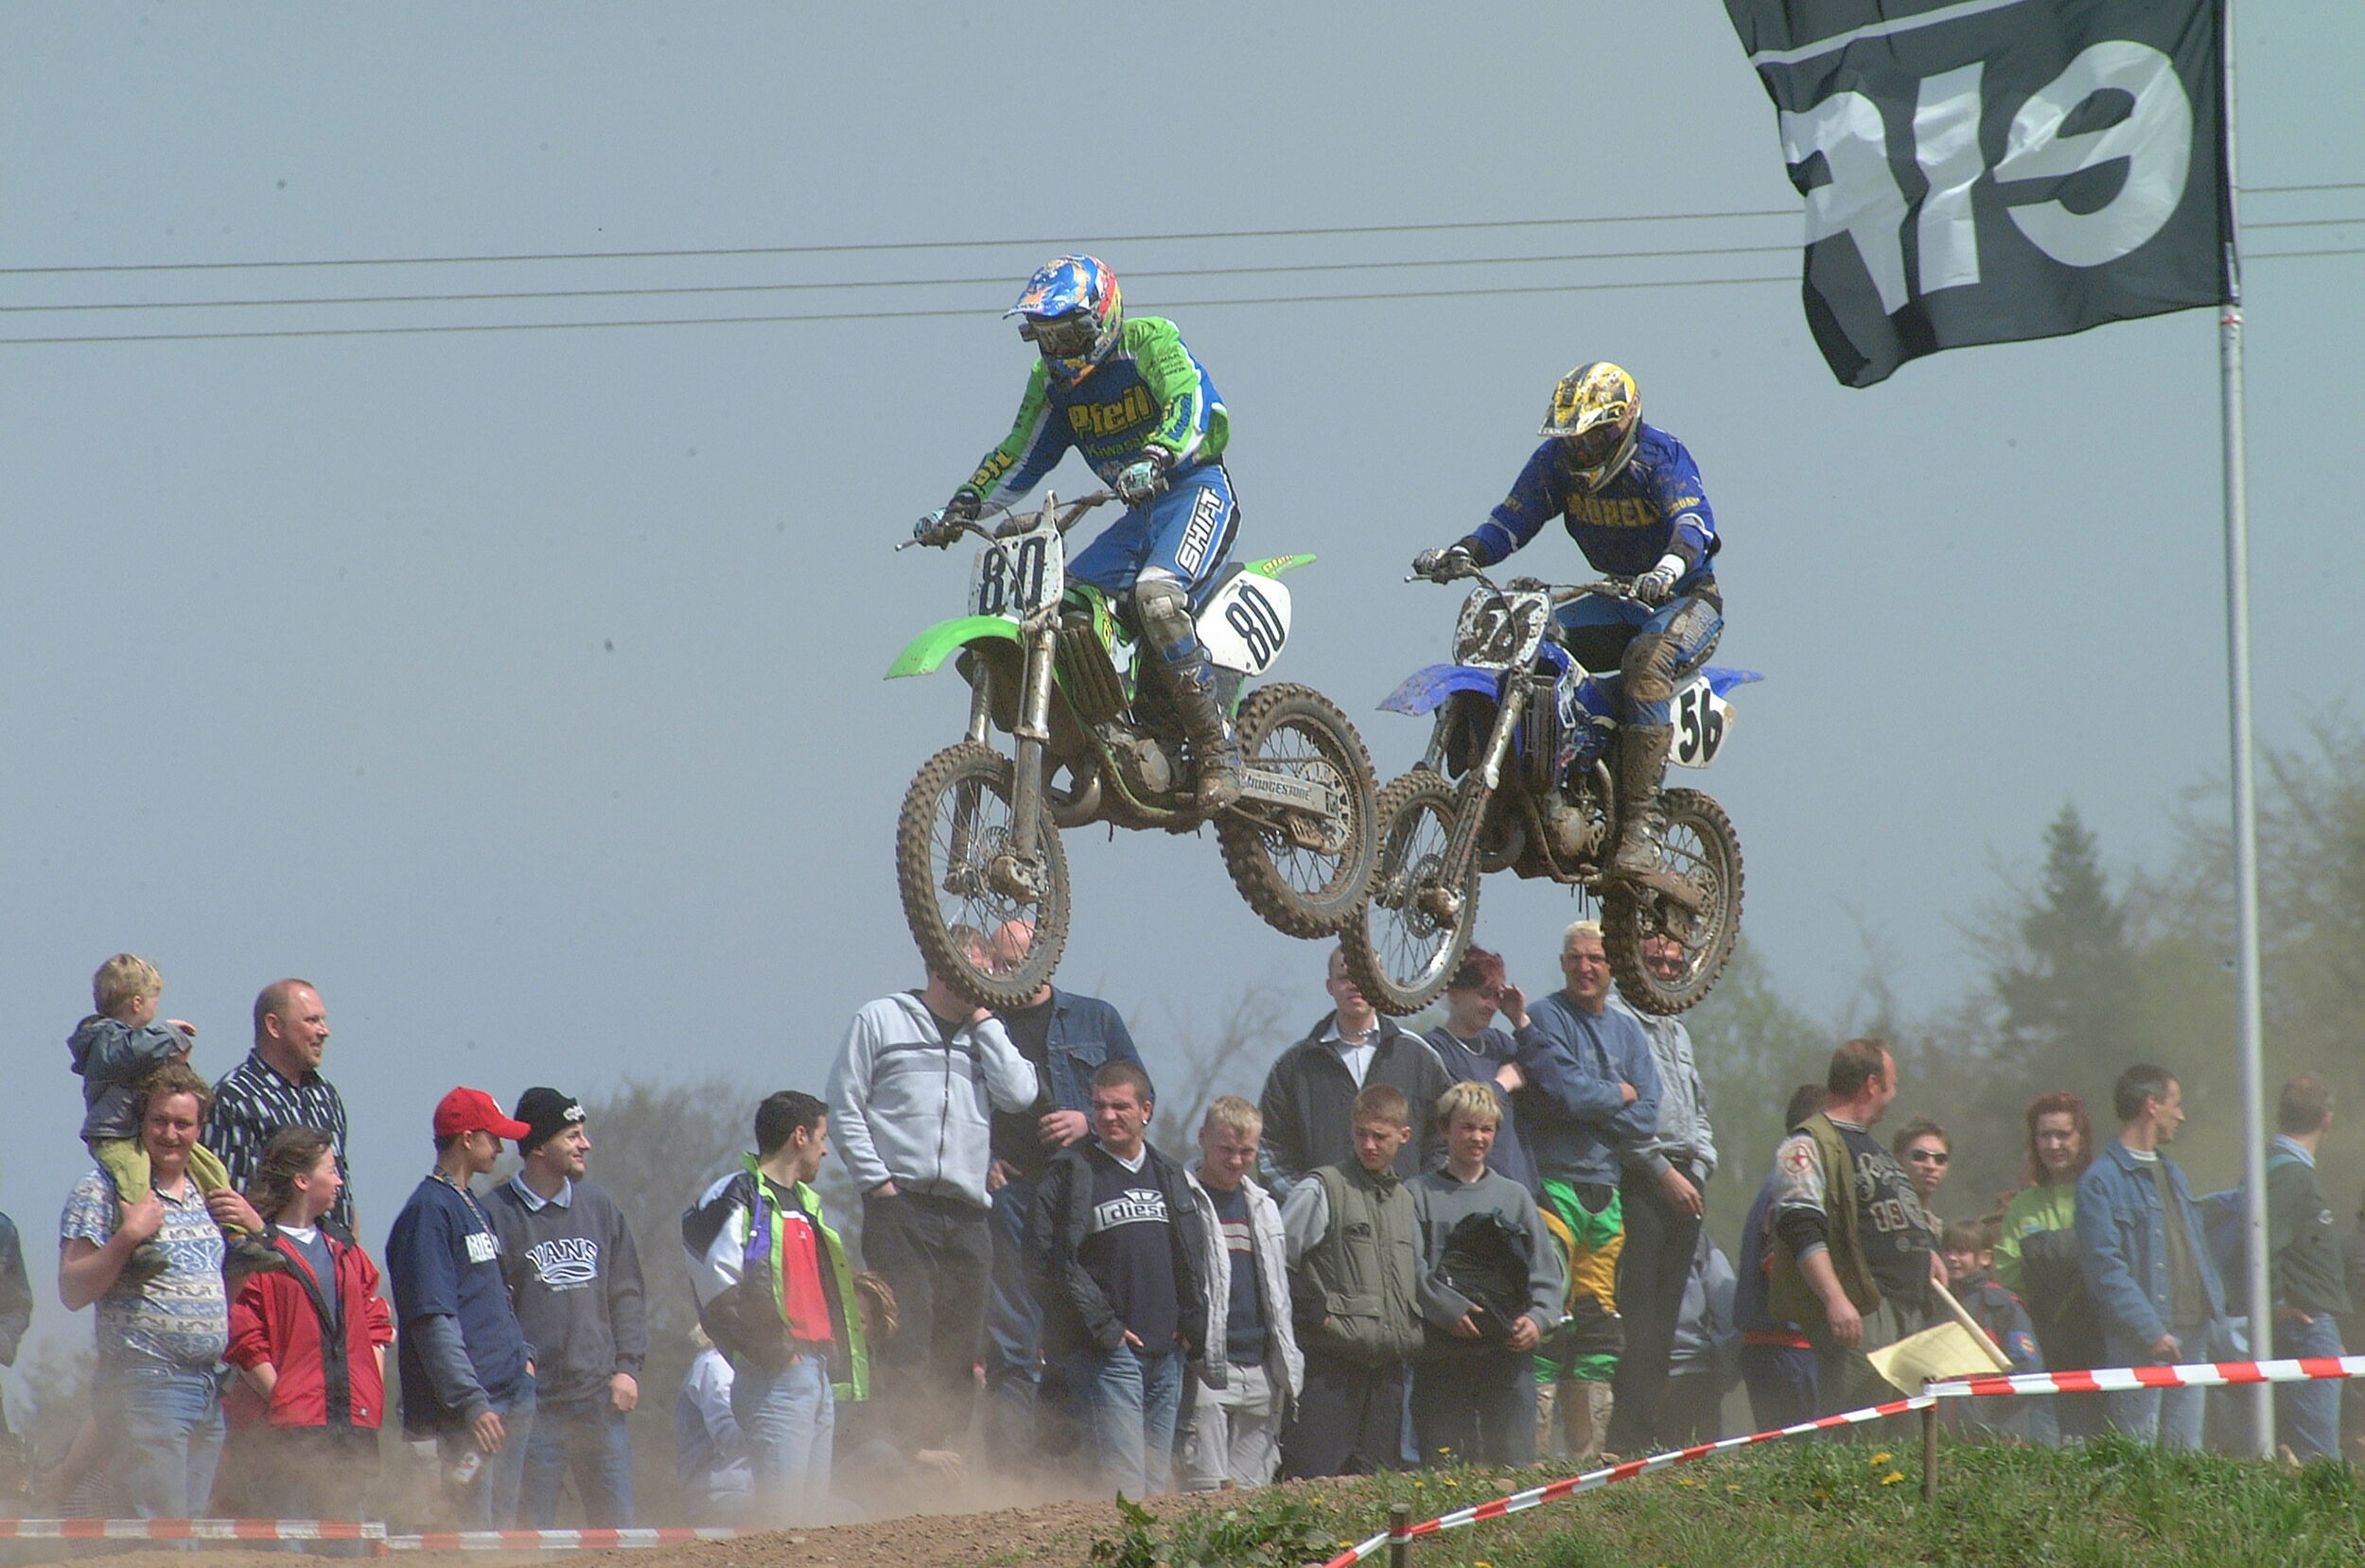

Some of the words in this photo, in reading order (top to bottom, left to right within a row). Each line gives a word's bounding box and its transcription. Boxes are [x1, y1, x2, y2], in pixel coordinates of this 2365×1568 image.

[1068, 385, 1151, 438] Pfeil
[1179, 486, 1224, 577] SHIFT
[979, 536, 1047, 617] 80
[1225, 584, 1285, 671] 80
[1679, 688, 1723, 762] 56
[525, 1237, 598, 1270] VANS
